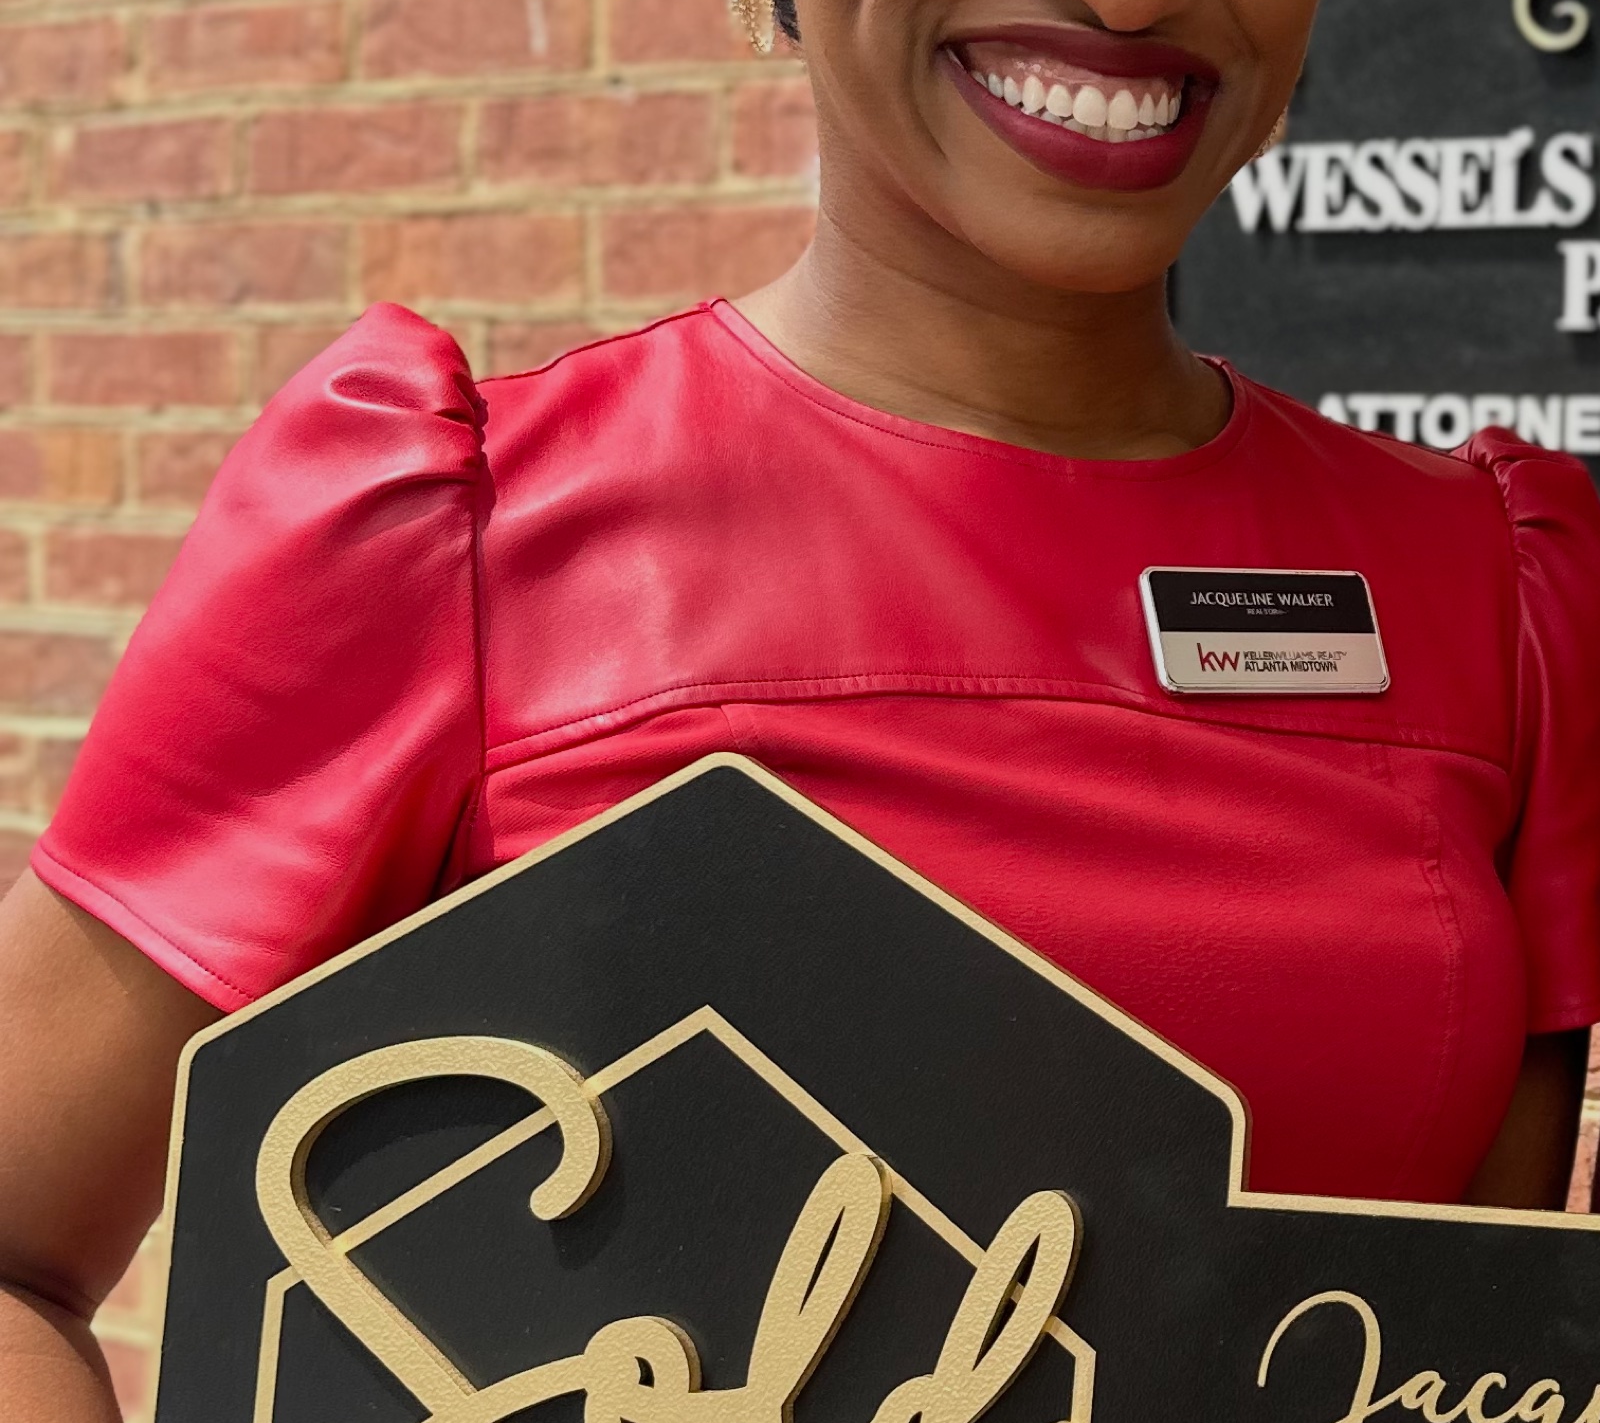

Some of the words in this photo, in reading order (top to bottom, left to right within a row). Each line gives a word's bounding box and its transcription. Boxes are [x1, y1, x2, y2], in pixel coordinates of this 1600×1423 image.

[1190, 591, 1275, 607] JACQUELINE
[1277, 593, 1335, 607] WALKER
[1244, 661, 1289, 672] ATLANTA
[1290, 661, 1338, 673] MIDTOWN
